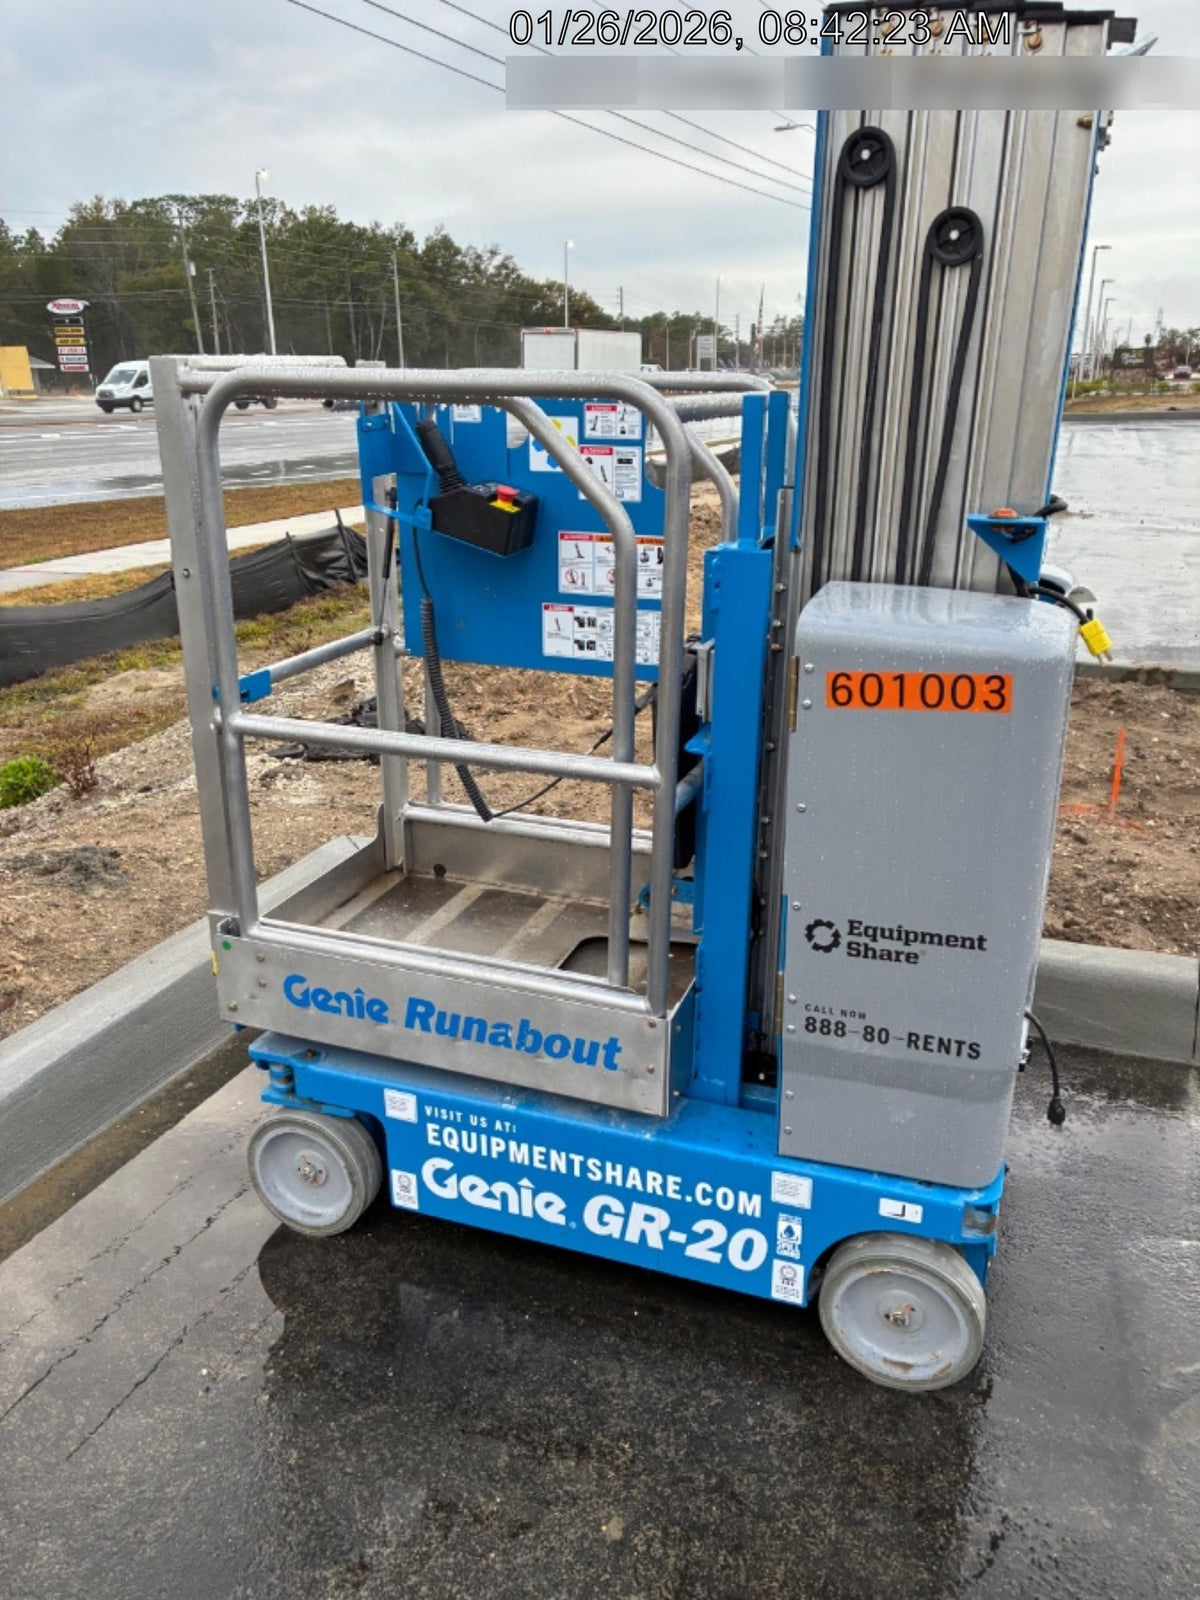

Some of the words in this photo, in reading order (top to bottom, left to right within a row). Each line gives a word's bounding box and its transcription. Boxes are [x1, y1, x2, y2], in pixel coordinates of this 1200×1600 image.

[830, 671, 1007, 711] 601003
[845, 940, 921, 965] Share
[846, 918, 988, 952] Equipment
[804, 1002, 836, 1016] CALL
[840, 1009, 868, 1021] NOW
[403, 996, 623, 1072] Runabout
[804, 1015, 982, 1061] 888-80-RENTS
[423, 1104, 463, 1123] VISIT
[468, 1113, 489, 1129] US
[493, 1118, 517, 1134] AT:
[425, 1122, 763, 1219] EQUIPMENTSHARE.COM
[581, 1194, 770, 1272] GR-20
